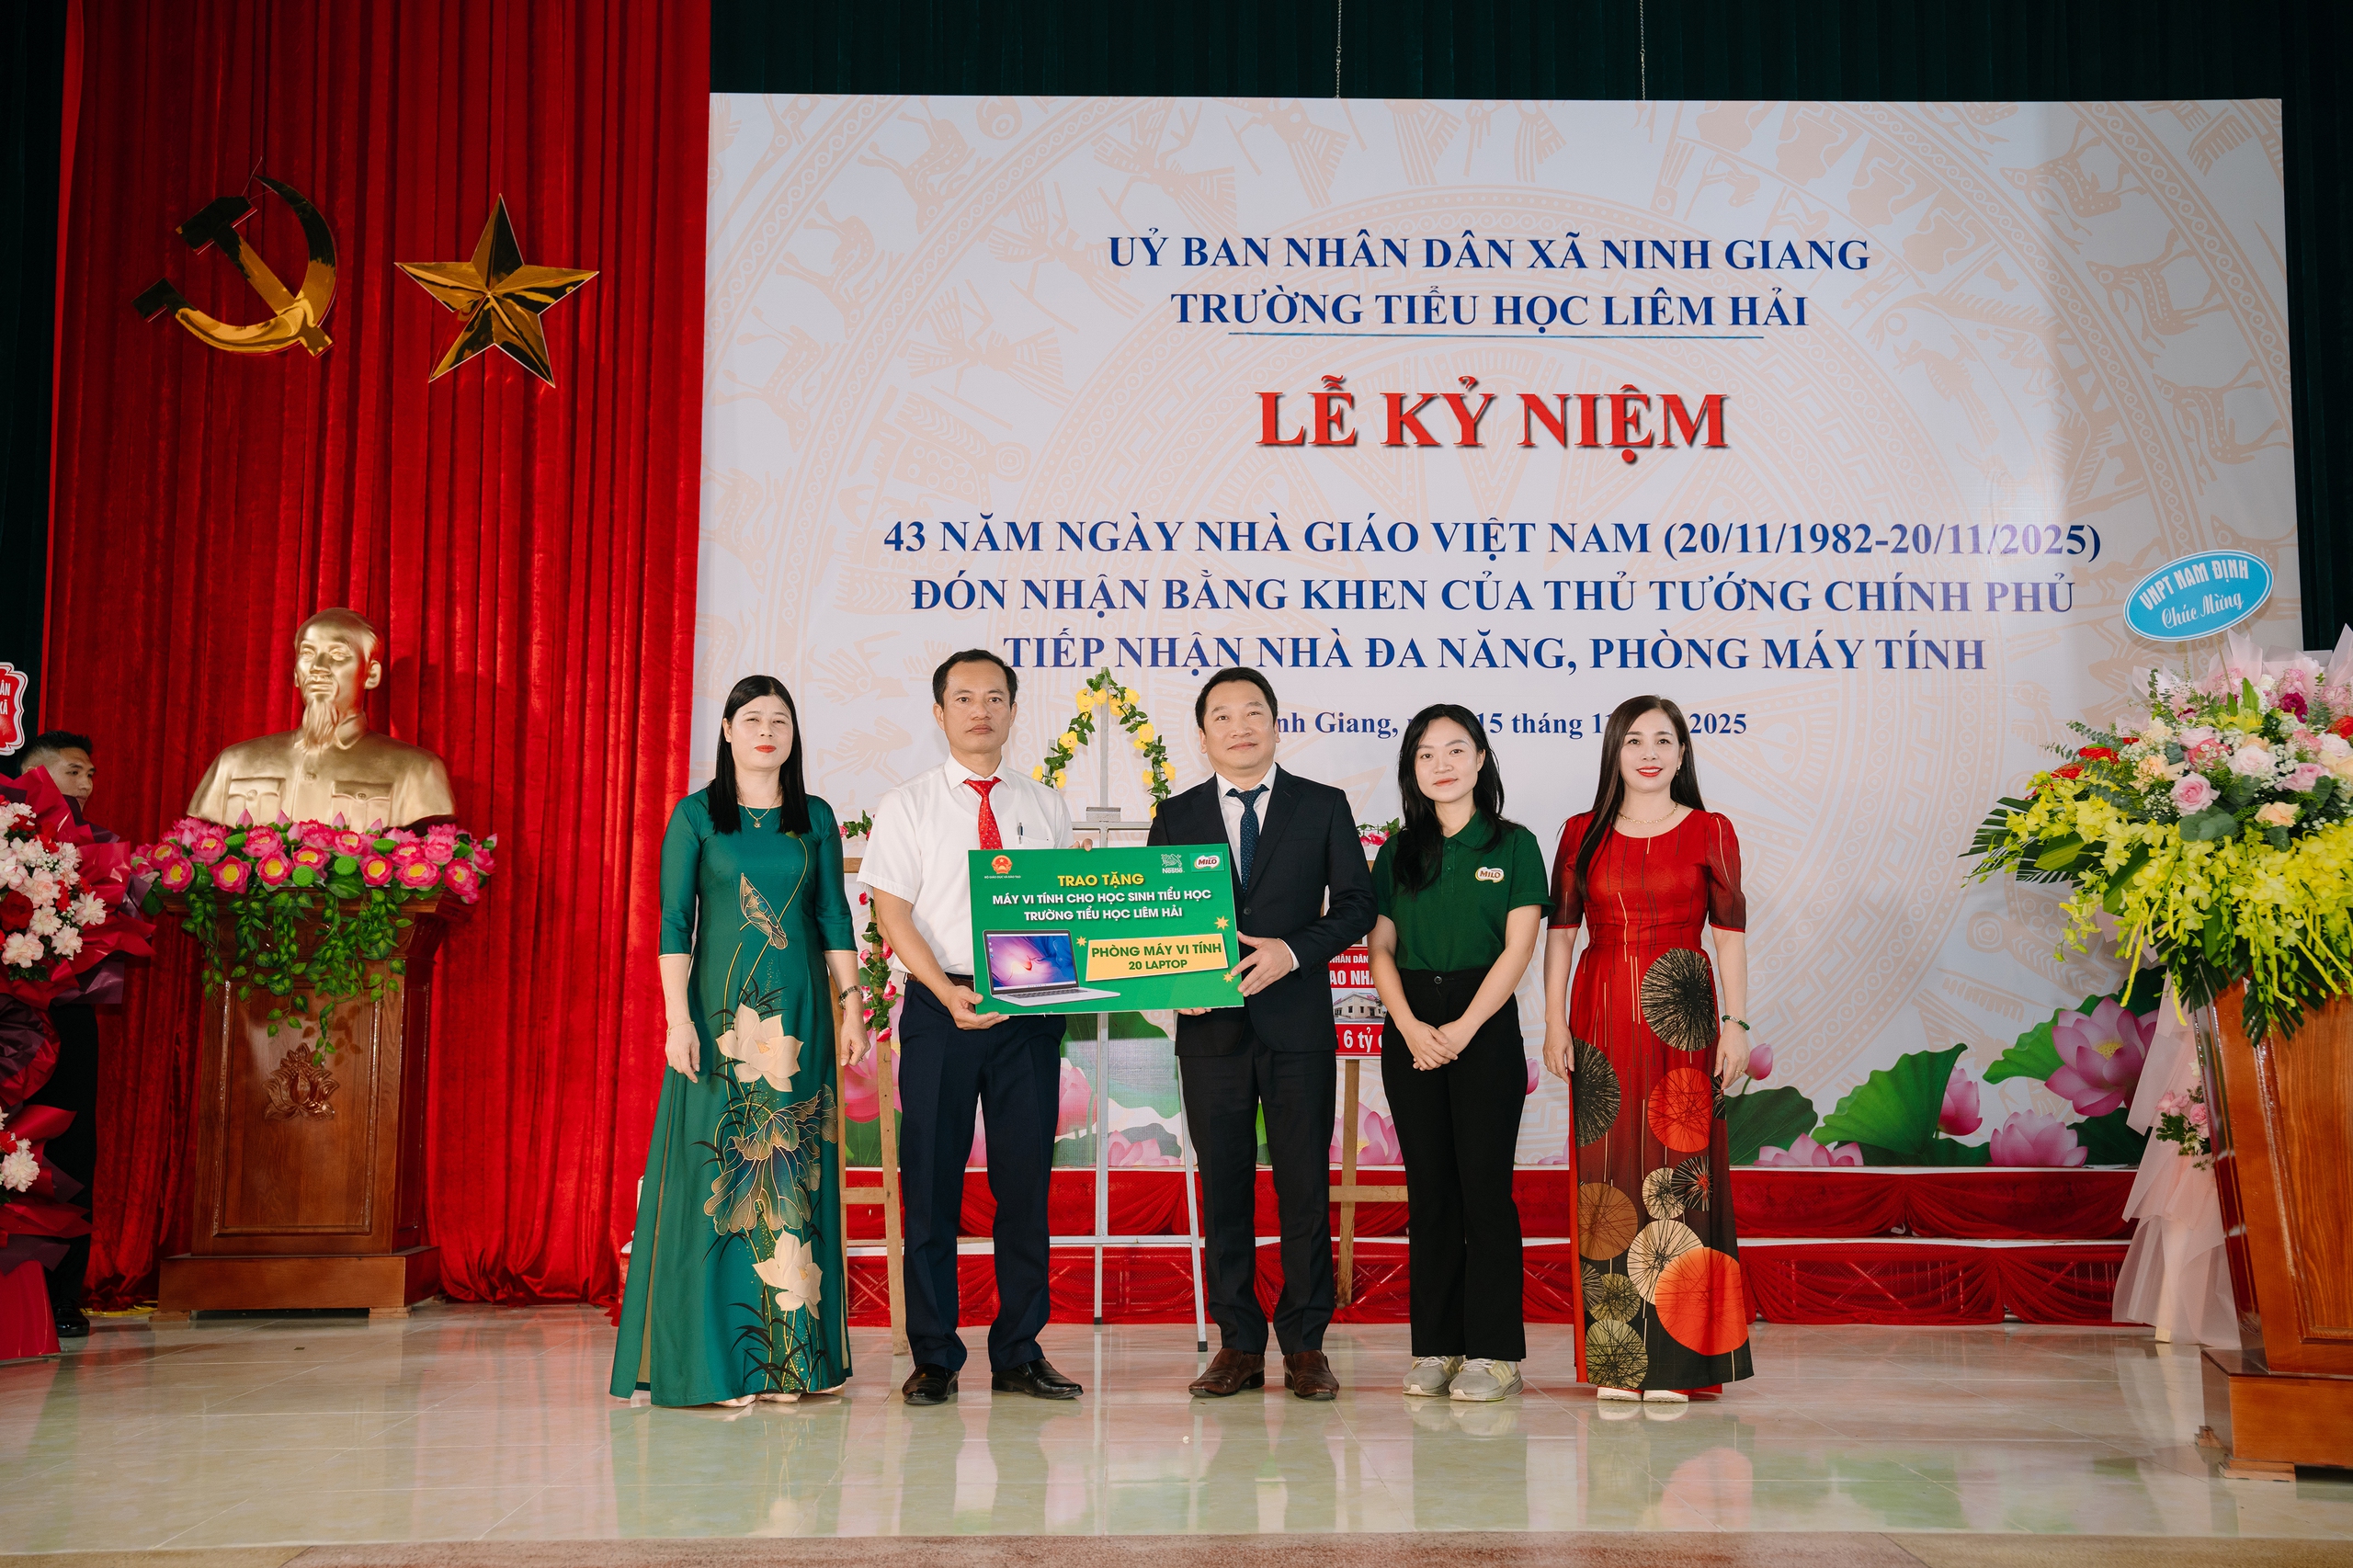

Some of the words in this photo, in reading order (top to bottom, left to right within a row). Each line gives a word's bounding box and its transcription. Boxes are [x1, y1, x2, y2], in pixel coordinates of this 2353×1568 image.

[1108, 228, 1171, 267] UỶ
[1182, 236, 1270, 267] BAN
[1285, 230, 1409, 267] NHÂN
[1425, 230, 1515, 268] DÂN
[1530, 232, 1589, 269] XÃ
[1601, 240, 1711, 269] NINH
[1724, 240, 1870, 270] GIANG
[1171, 287, 1363, 324] TRƯỜNG
[1375, 286, 1478, 324] TIỂU
[1494, 295, 1592, 335] HỌC
[1603, 286, 1714, 326] LIÊM
[1727, 286, 1808, 326] HẢI
[1256, 374, 1357, 448] LỄ
[1380, 375, 1495, 447] KỶ
[1516, 383, 1729, 464] NIỆM
[883, 521, 926, 552] 43
[938, 513, 1041, 551] NĂM
[1056, 511, 1183, 551] NGÀY
[1195, 511, 1290, 551] NHÀ
[1303, 511, 1419, 552] GIÁO
[1432, 517, 1536, 562] VIỆT
[1548, 522, 1651, 553] NAM
[1664, 522, 2102, 562] (20/11/1982-20/11/2025)
[911, 570, 1006, 610] ĐÓN
[1021, 574, 1149, 619] NHẬN
[1162, 567, 1287, 609] BẰNG
[1302, 580, 1427, 609] KHEN
[1440, 571, 1533, 611] CỦA
[1544, 572, 1636, 611] THỦ
[1648, 571, 1811, 611] TƯỚNG
[1824, 572, 1969, 611] CHÍNH
[1984, 573, 2075, 611] PHỦ
[2139, 575, 2175, 611] VNPT
[2173, 562, 2210, 591] NAM
[2211, 559, 2249, 583] ĐỊNH
[2161, 604, 2200, 630] Chúc
[2200, 592, 2245, 618] Mừng
[1004, 627, 1106, 667] TIẾP
[1113, 631, 1242, 676] NHẬN
[1257, 628, 1353, 667] NHÀ
[1365, 638, 1428, 668] ĐA
[1437, 629, 1578, 676] NĂNG,
[1590, 629, 1748, 669] PHÒNG
[1762, 629, 1872, 669] MÁY
[1875, 630, 1987, 669] TÍNH
[1276, 711, 1306, 733] nh
[1314, 711, 1399, 739] Giang,
[1511, 711, 1583, 740] tháng
[1591, 713, 1611, 733] 1
[1689, 712, 1747, 734] 2025
[1198, 858, 1218, 866] MILO
[1480, 870, 1501, 879] MILO
[1057, 874, 1098, 888] TRAO
[1102, 871, 1145, 889] TẶNG
[993, 892, 1019, 905] MÁY
[1022, 894, 1036, 905] VI
[1039, 892, 1063, 904] TÍNH
[1065, 892, 1095, 904] CHO
[1097, 892, 1125, 906] HỌC
[1128, 891, 1156, 903] SINH
[1157, 886, 1181, 902] TIỂU
[1183, 889, 1211, 903] HỌC
[1024, 907, 1074, 922] TRƯỜNG
[1076, 905, 1100, 921] TIỂU
[1102, 908, 1131, 922] HỌC
[1134, 905, 1159, 919] LIÊM
[1162, 904, 1183, 918] HẢI
[1091, 942, 1141, 959] PHÒNG
[1142, 942, 1175, 957] MÁY
[1176, 943, 1189, 956] VI
[1191, 938, 1222, 955] TÍNH
[1128, 960, 1142, 971] 20
[1145, 959, 1188, 971] LAPTOP
[1343, 1028, 1354, 1049] 6
[1358, 1026, 1374, 1053] tỷ
